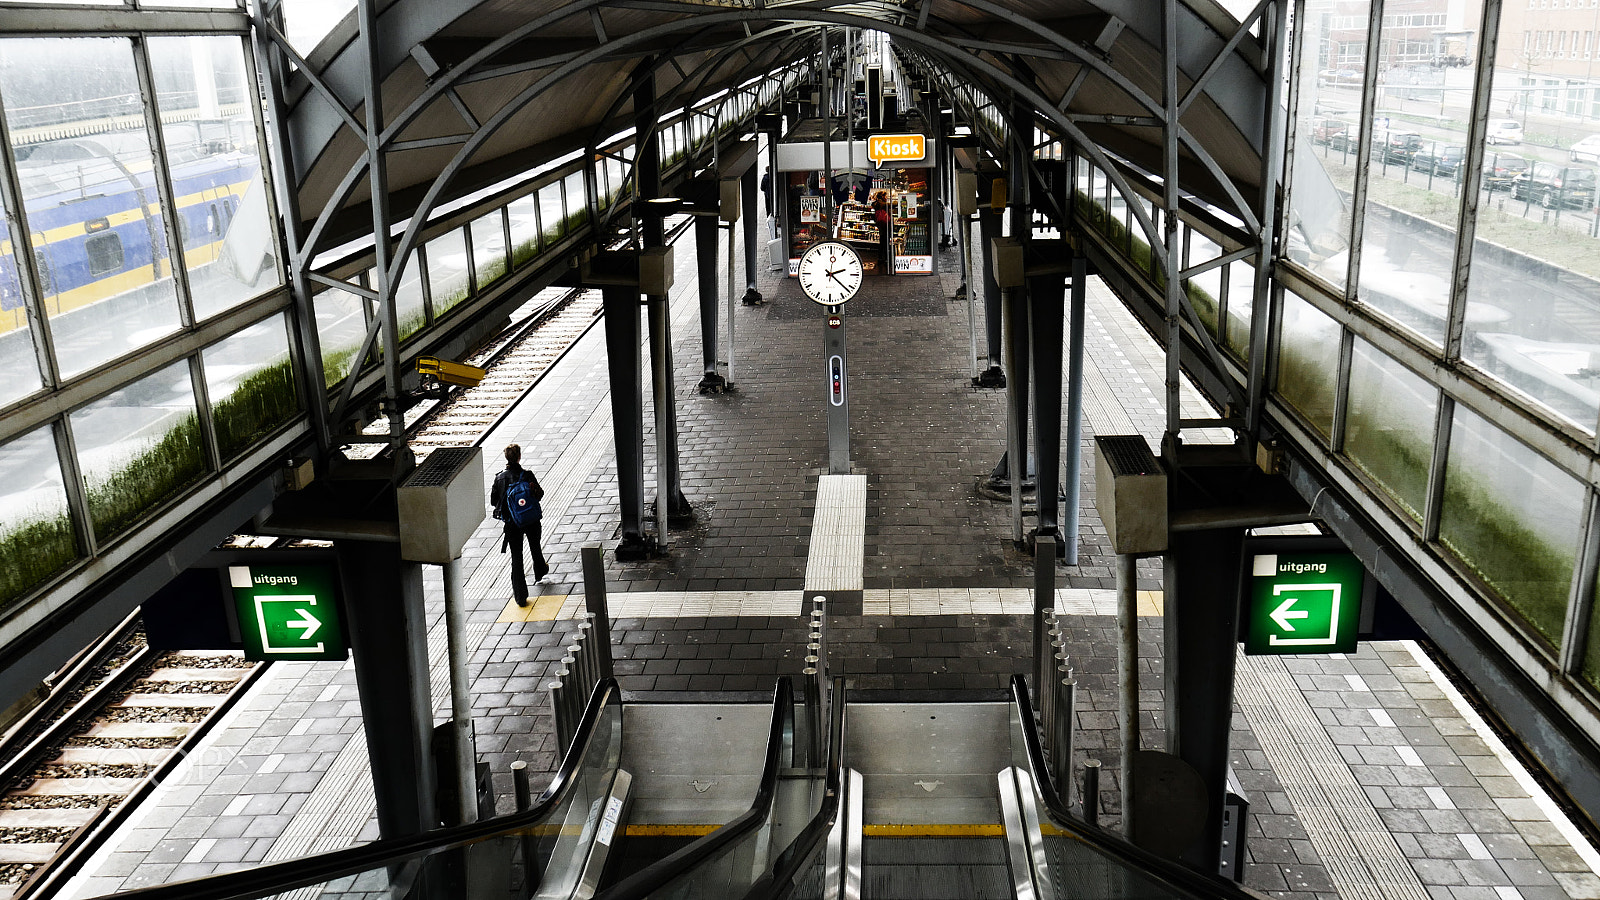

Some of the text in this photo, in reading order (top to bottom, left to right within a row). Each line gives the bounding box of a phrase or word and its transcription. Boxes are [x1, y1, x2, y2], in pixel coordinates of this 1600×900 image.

[874, 139, 920, 156] Kiosk
[1280, 562, 1327, 574] uitgang
[254, 574, 298, 586] uitgang
